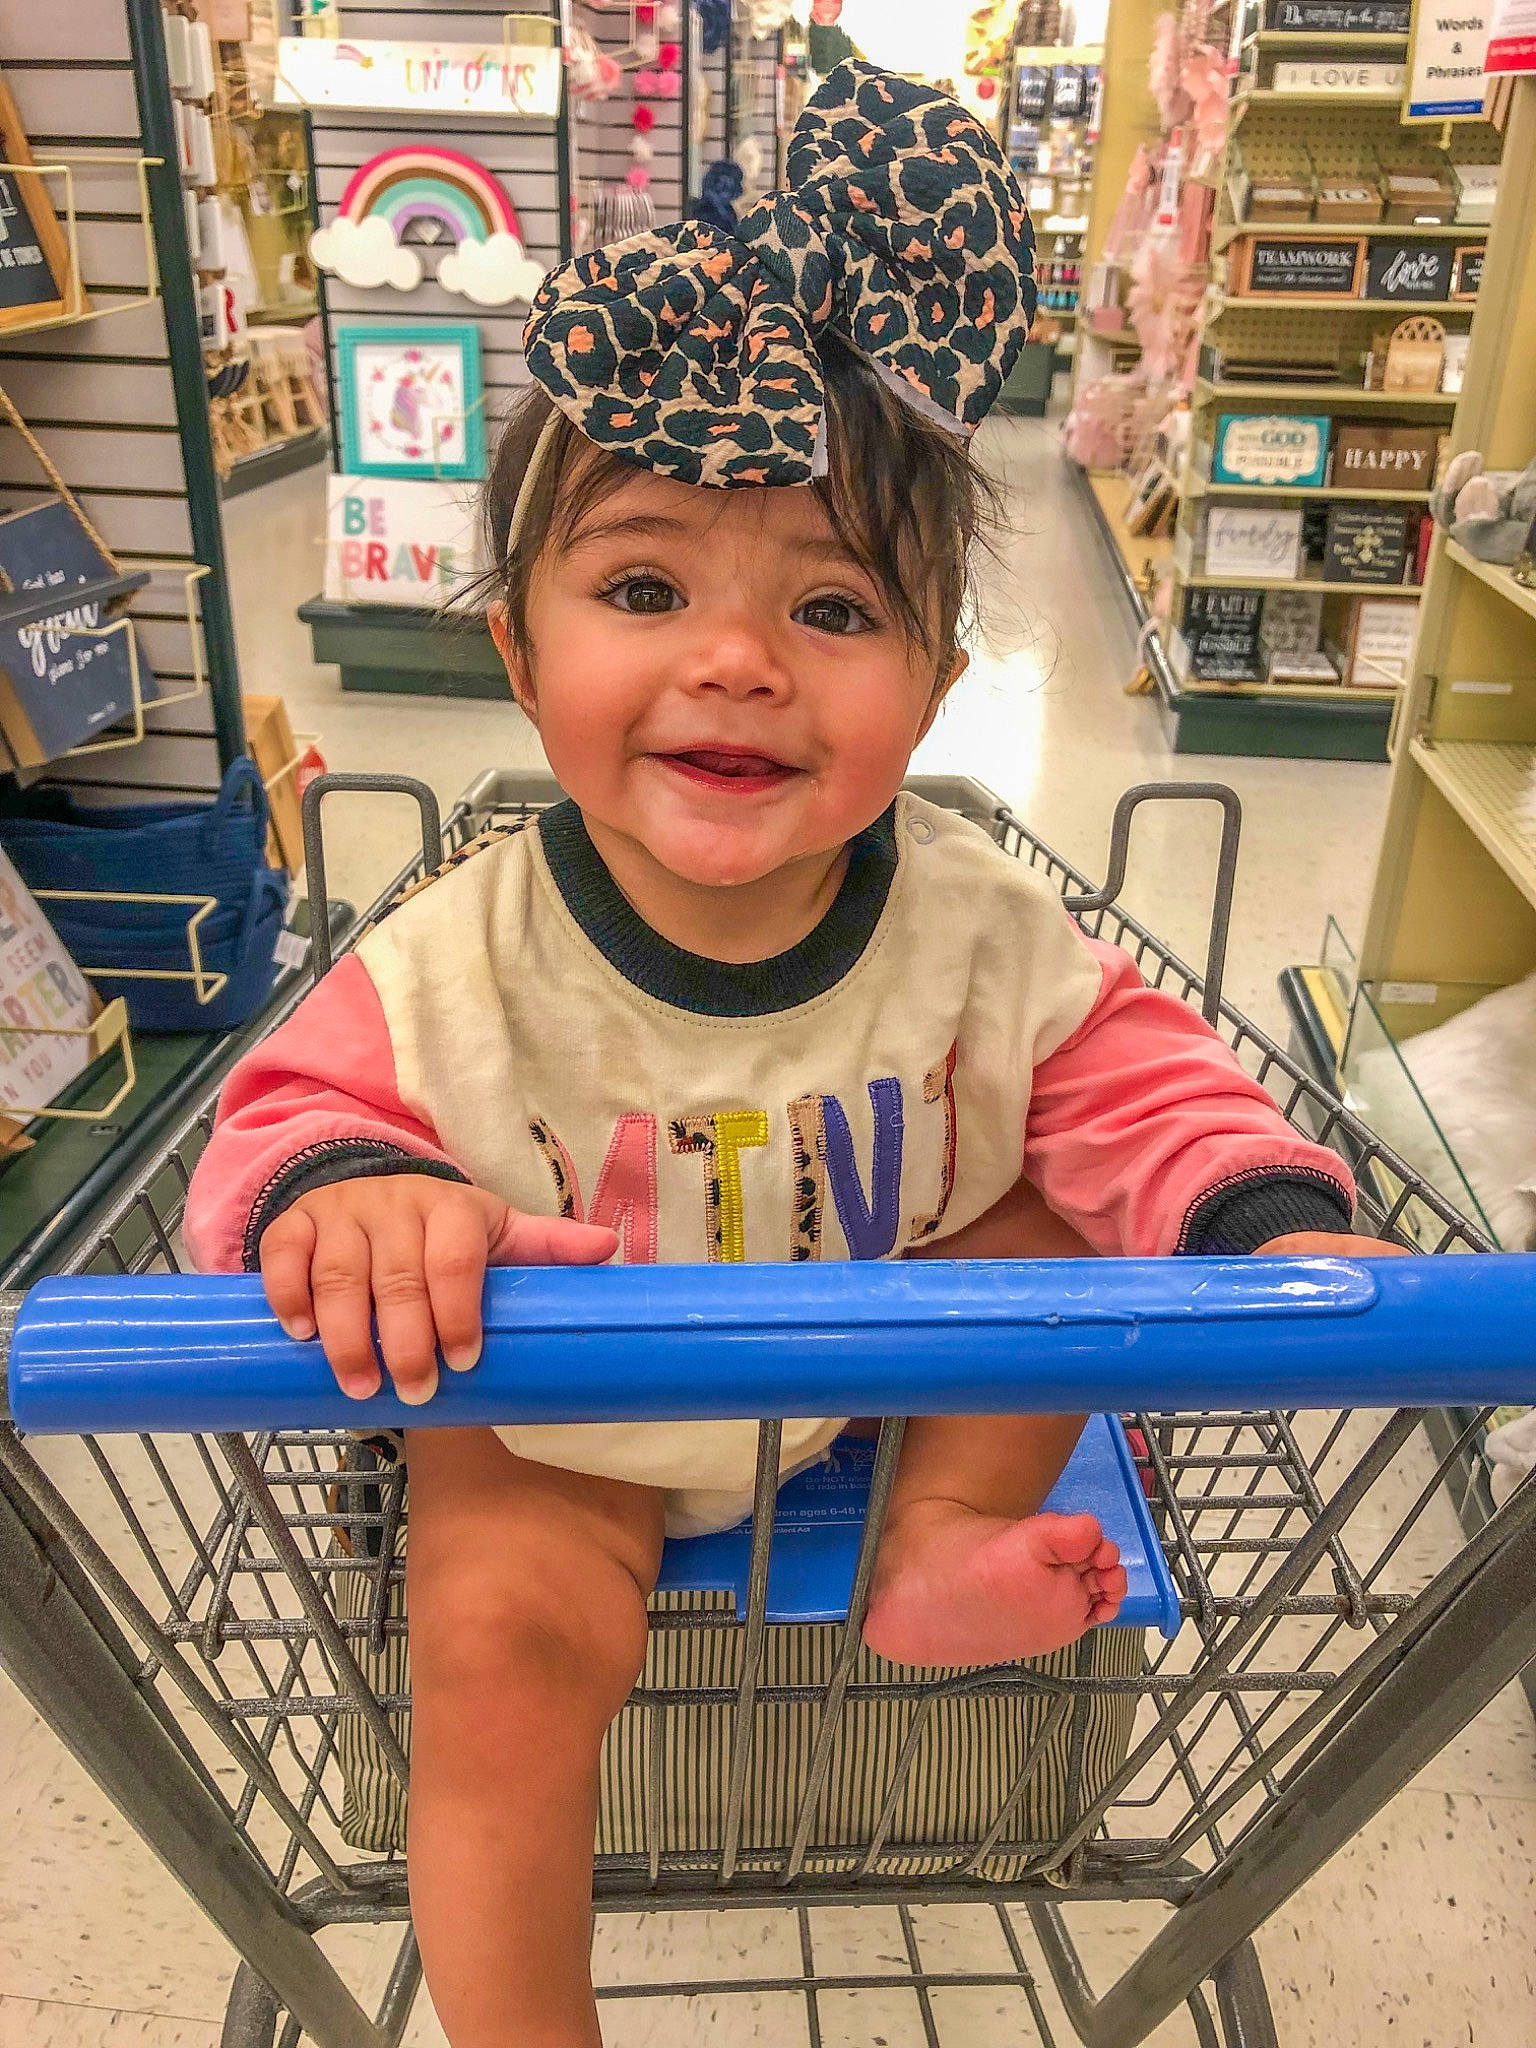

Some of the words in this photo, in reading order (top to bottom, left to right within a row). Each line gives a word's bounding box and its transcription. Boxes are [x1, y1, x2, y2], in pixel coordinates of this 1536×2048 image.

[1436, 17, 1484, 32] Words
[1451, 41, 1463, 54] &
[1310, 68, 1370, 86] LOVE
[1426, 65, 1483, 79] Phrases
[1345, 448, 1427, 471] HAPPY
[343, 496, 386, 537] BE
[340, 537, 458, 585] BRAVE
[823, 1475, 846, 1484] NOT
[805, 1483, 816, 1491] to
[818, 1483, 837, 1491] ride
[838, 1483, 849, 1491] in
[800, 1508, 828, 1519] ages
[829, 1506, 856, 1516] 6-48
